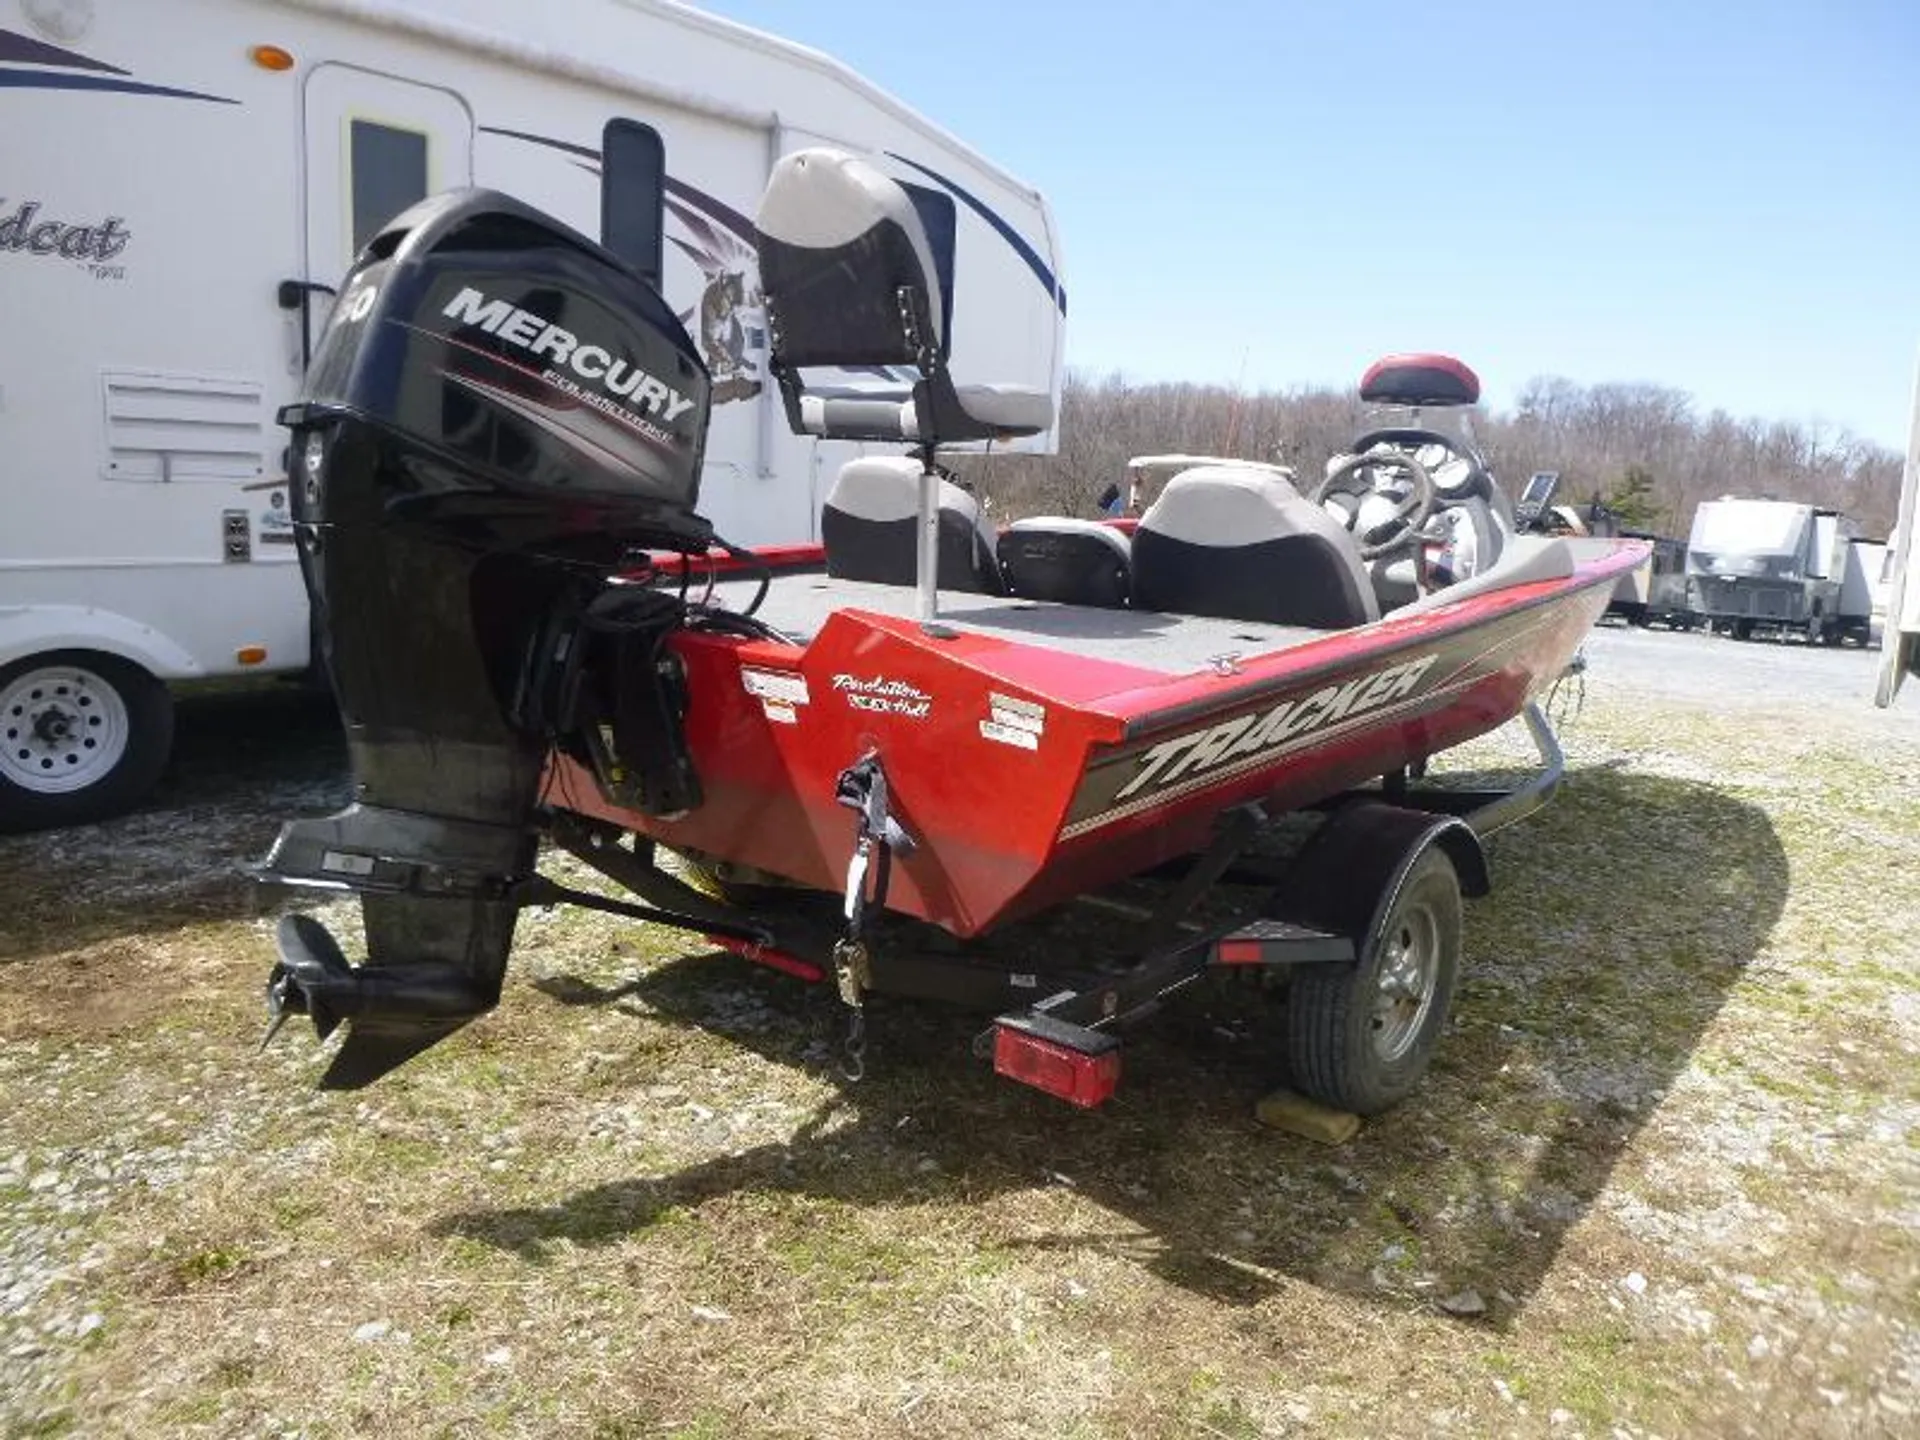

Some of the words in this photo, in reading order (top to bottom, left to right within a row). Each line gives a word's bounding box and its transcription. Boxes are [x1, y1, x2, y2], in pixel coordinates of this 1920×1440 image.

[0, 197, 131, 262] dcat
[442, 287, 695, 422] MERCURY
[1114, 653, 1440, 800] TRACKER
